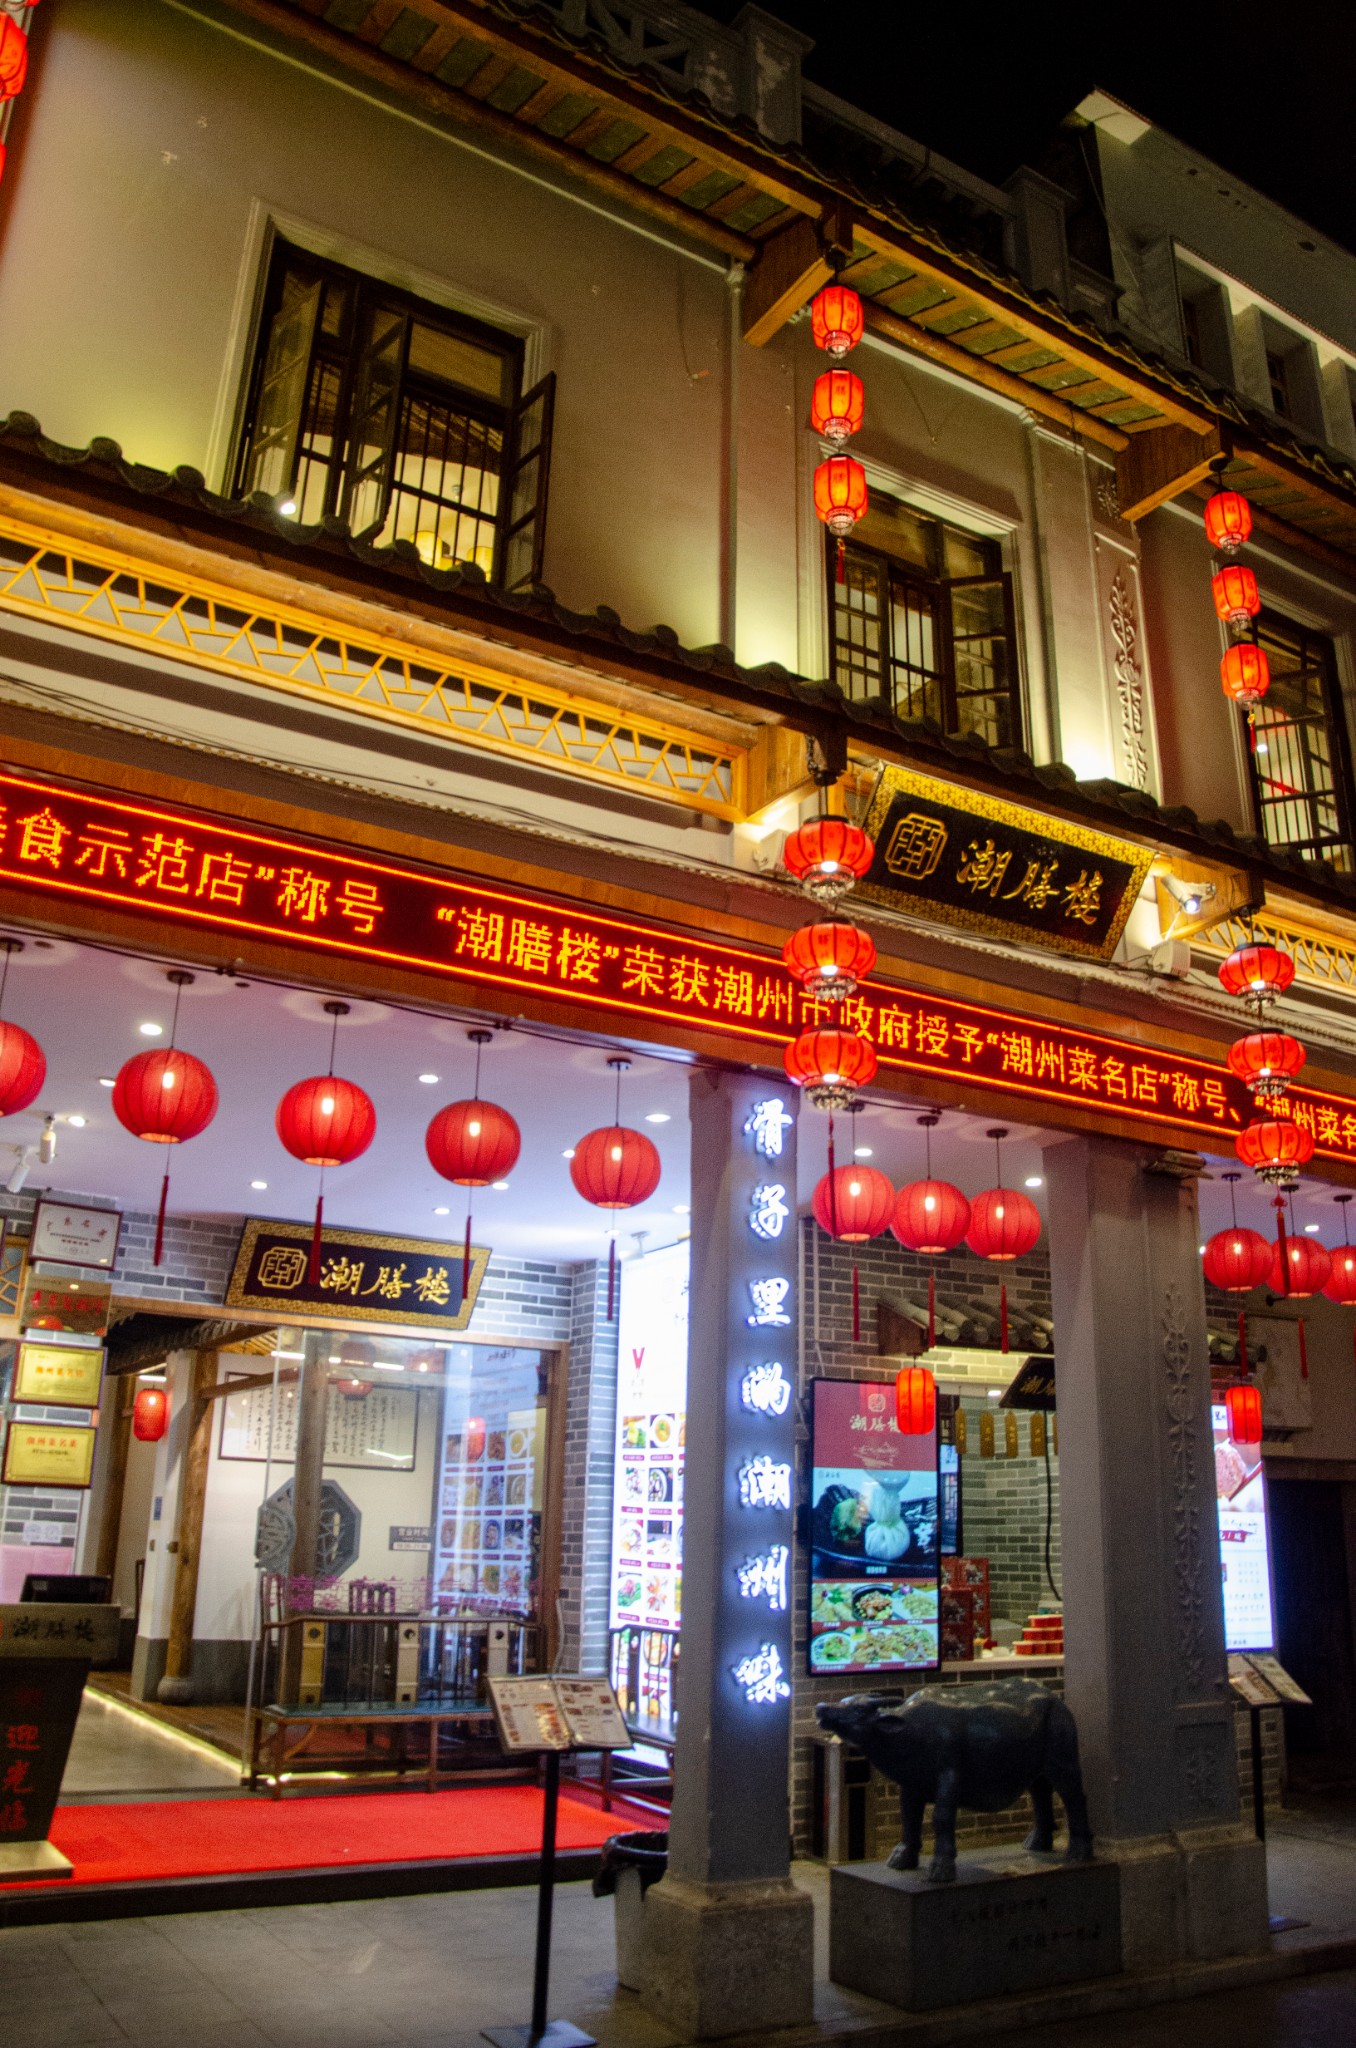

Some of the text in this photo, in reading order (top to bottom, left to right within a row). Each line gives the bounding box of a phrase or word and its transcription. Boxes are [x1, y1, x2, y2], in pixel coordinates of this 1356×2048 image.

[0, 807, 384, 934] 食示范店”称号
[740, 1098, 795, 1704] 骨子里的潮州味
